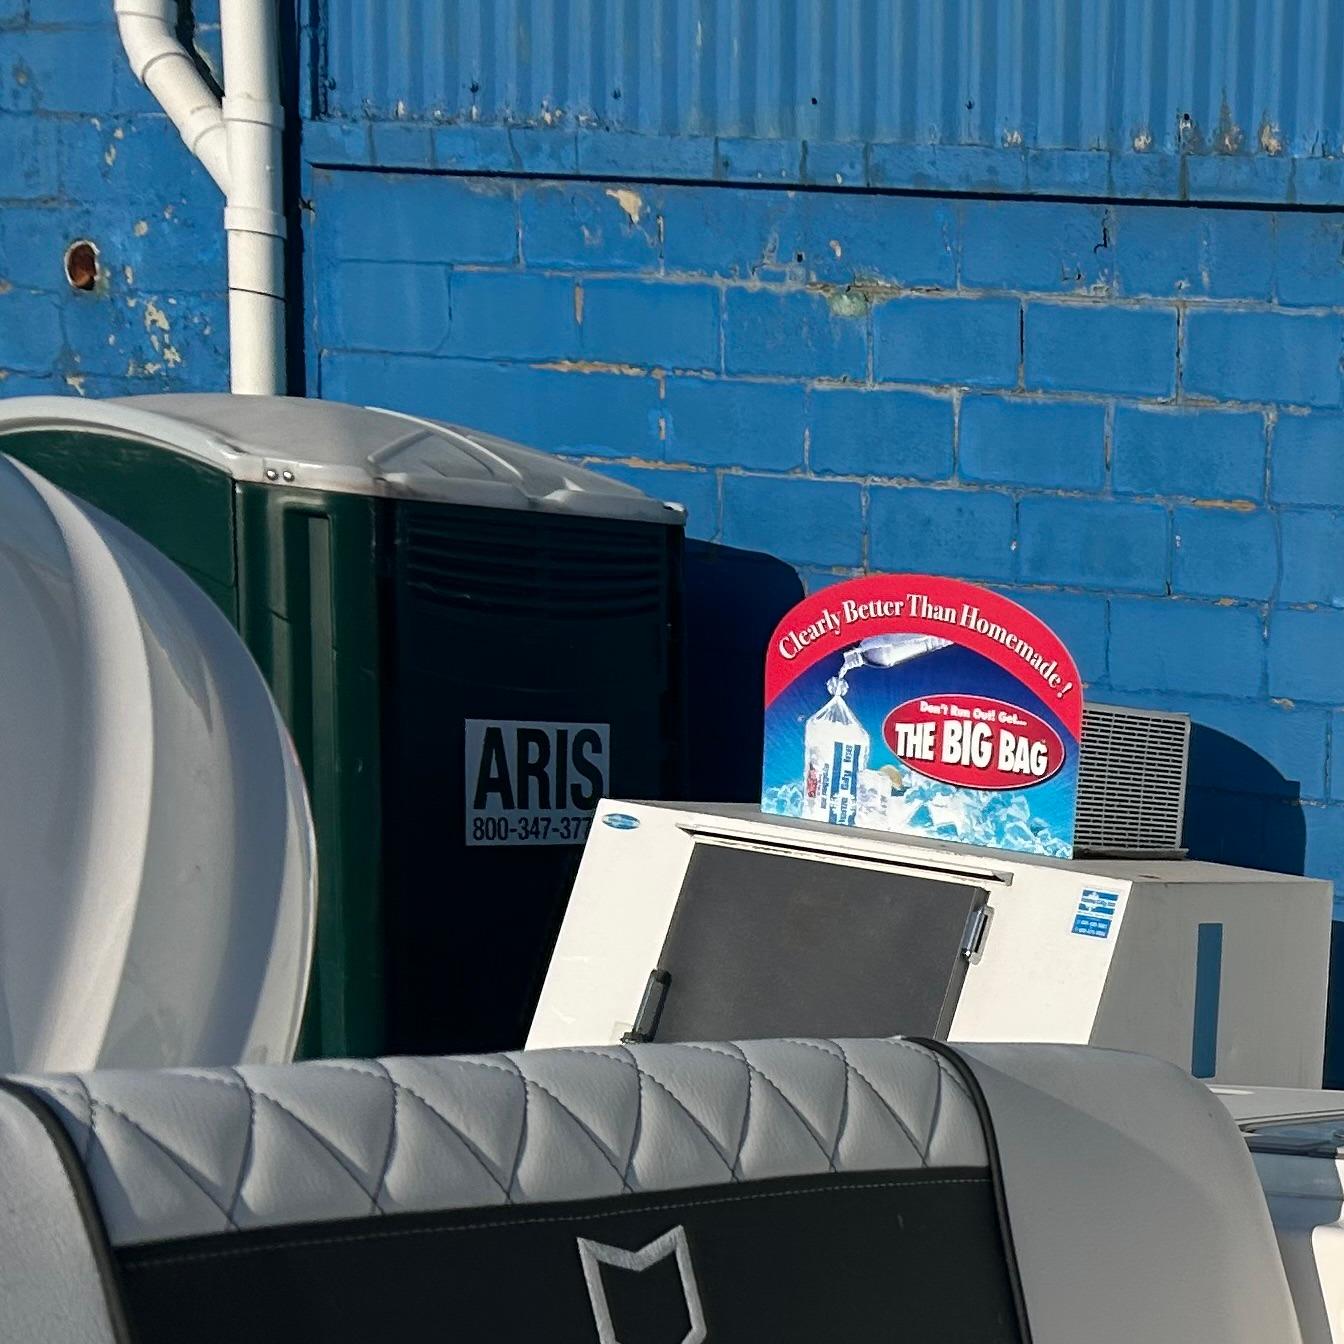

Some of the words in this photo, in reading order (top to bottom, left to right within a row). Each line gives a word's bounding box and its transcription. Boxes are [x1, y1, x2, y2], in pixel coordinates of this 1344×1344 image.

[778, 609, 842, 660] Clearly
[842, 600, 903, 622] Better
[906, 594, 957, 623] Than
[919, 700, 948, 716] Don't
[950, 705, 970, 718] Run
[972, 707, 996, 721] Out!
[473, 726, 604, 811] ARIS
[895, 722, 936, 761] THE
[941, 719, 993, 768] BIG
[997, 729, 1048, 776] BAG
[472, 816, 594, 841] 800-347-377
